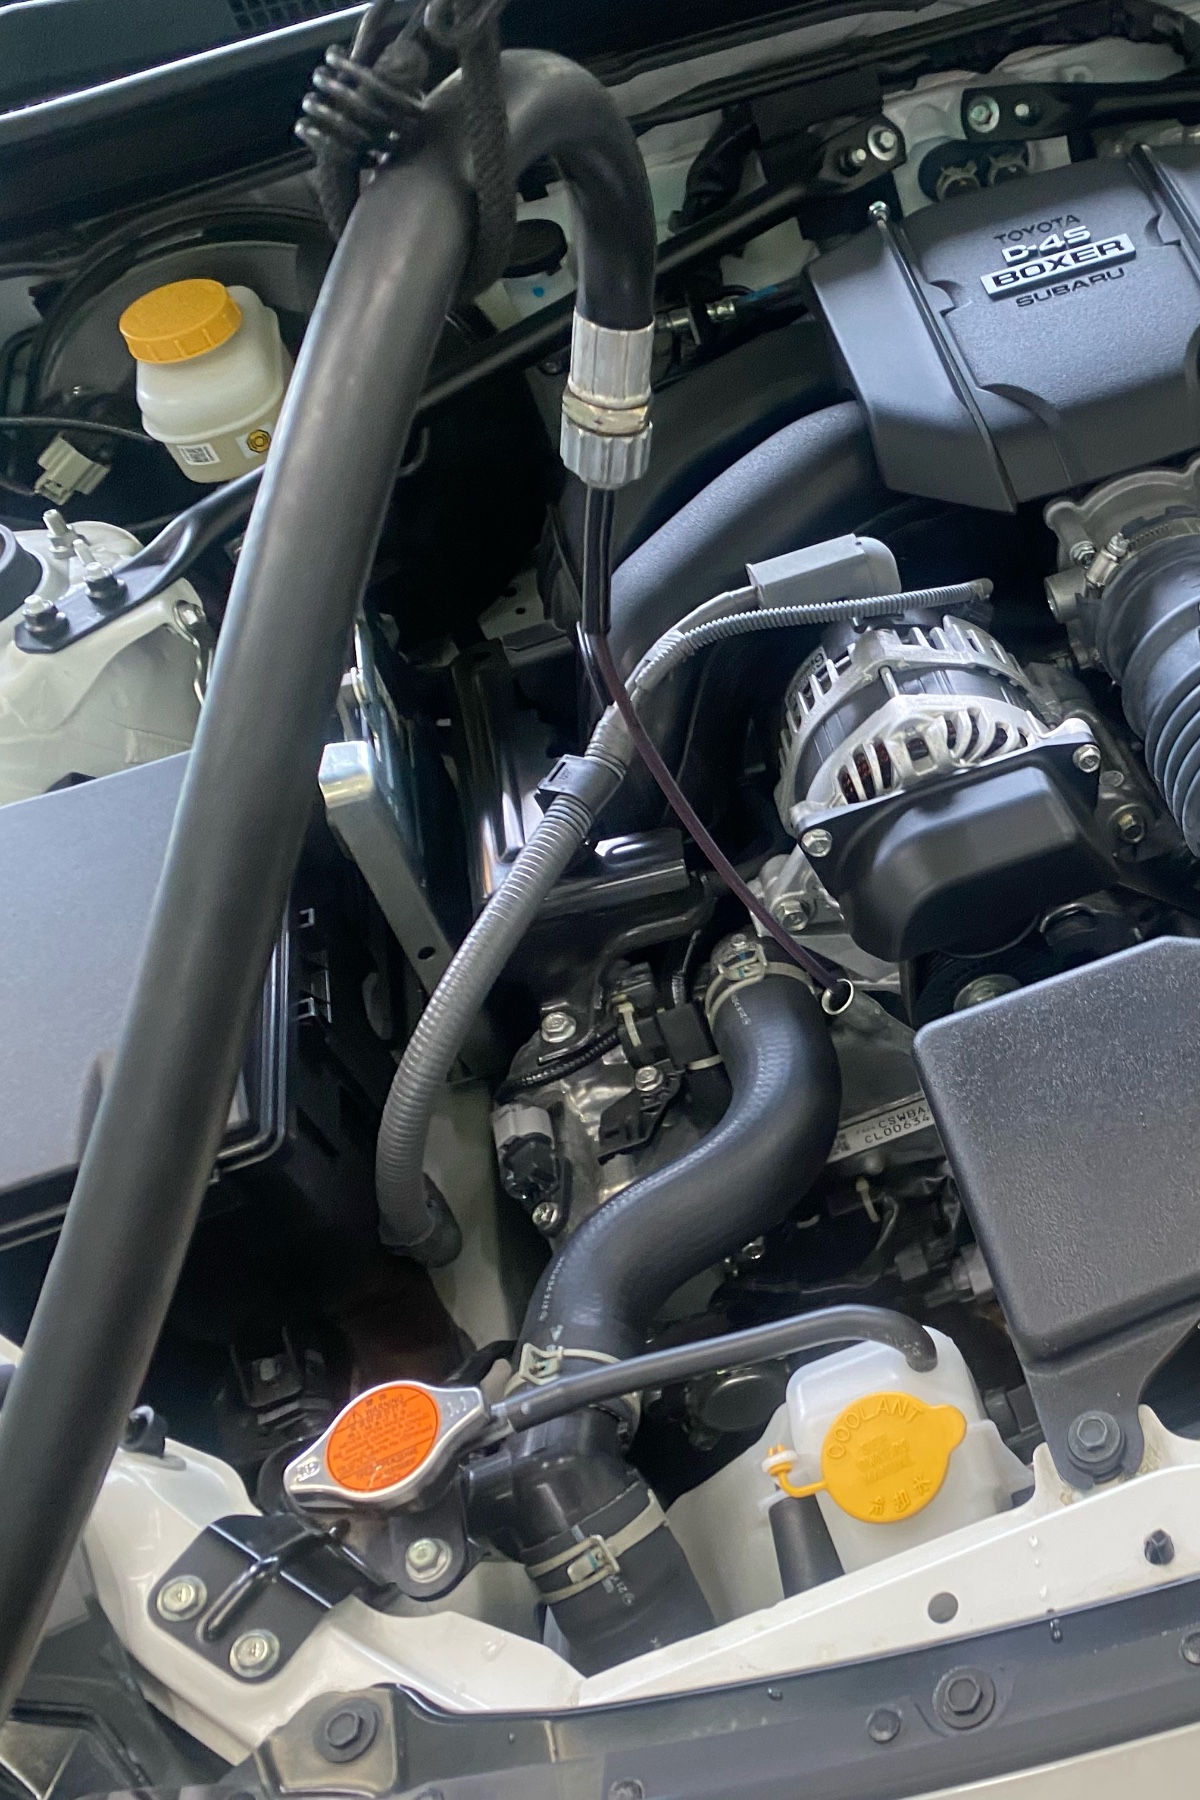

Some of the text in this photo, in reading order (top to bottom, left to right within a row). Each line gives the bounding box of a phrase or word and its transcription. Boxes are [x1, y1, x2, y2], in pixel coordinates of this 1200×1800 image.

[994, 214, 1080, 244] TOYOTA
[1001, 225, 1091, 264] D-4S
[992, 240, 1125, 287] BOXER
[1015, 267, 1125, 307] SUBARU
[826, 1397, 925, 1459] COOLANT
